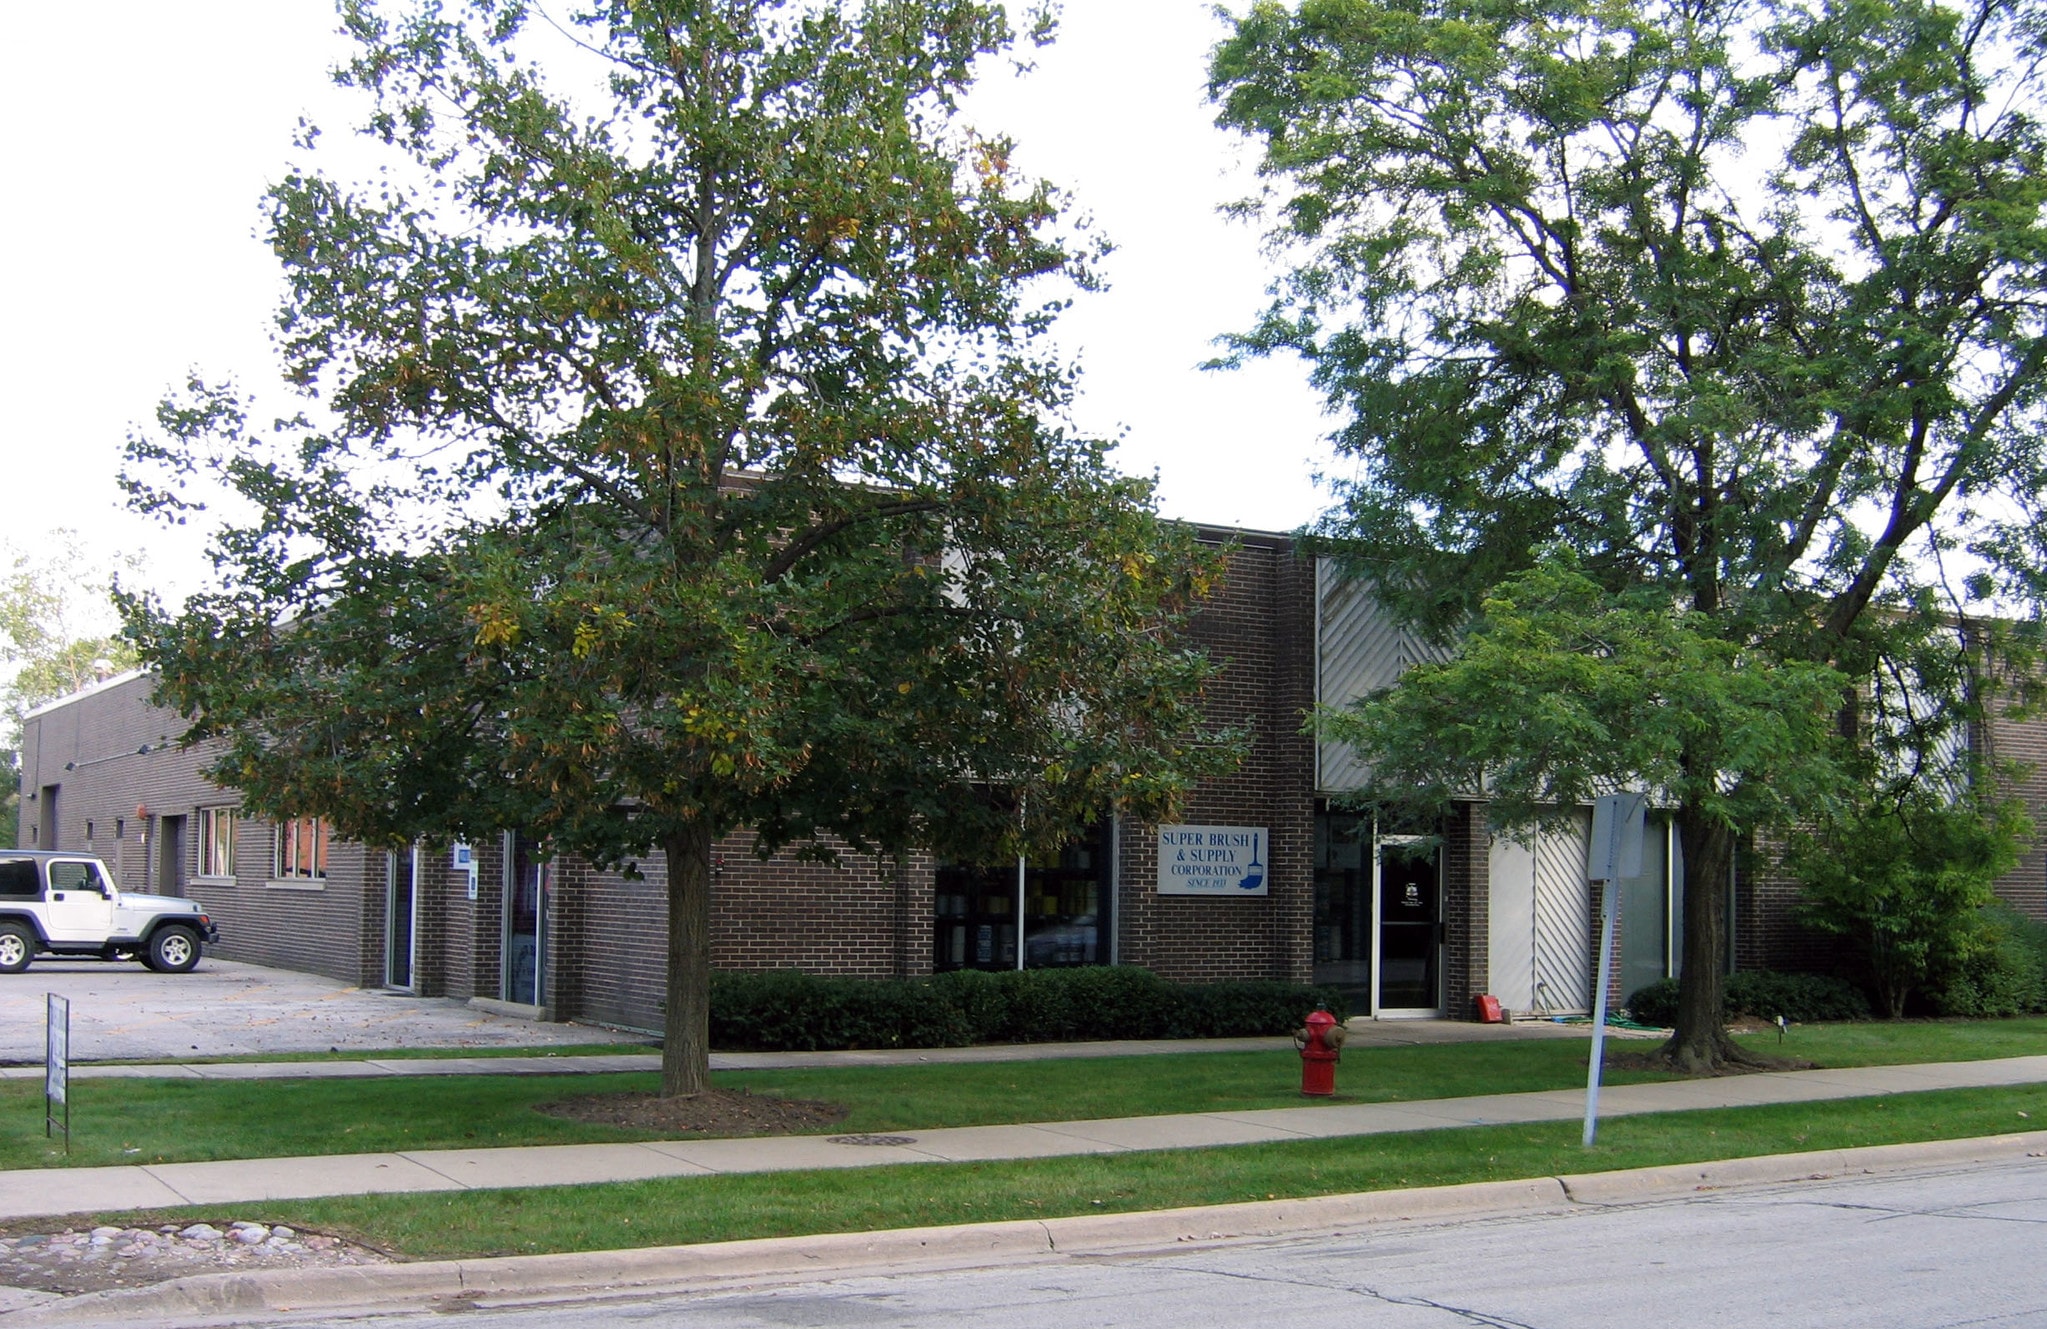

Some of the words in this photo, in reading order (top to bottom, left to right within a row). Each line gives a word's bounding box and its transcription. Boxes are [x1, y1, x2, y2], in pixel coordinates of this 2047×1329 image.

[1162, 832, 1203, 846] SUPER
[1209, 833, 1249, 847] BRUSH
[1176, 848, 1186, 861] &
[1190, 849, 1237, 862] SUPPLY
[1171, 864, 1242, 876] CORPORATION
[1187, 879, 1209, 888] SINCE
